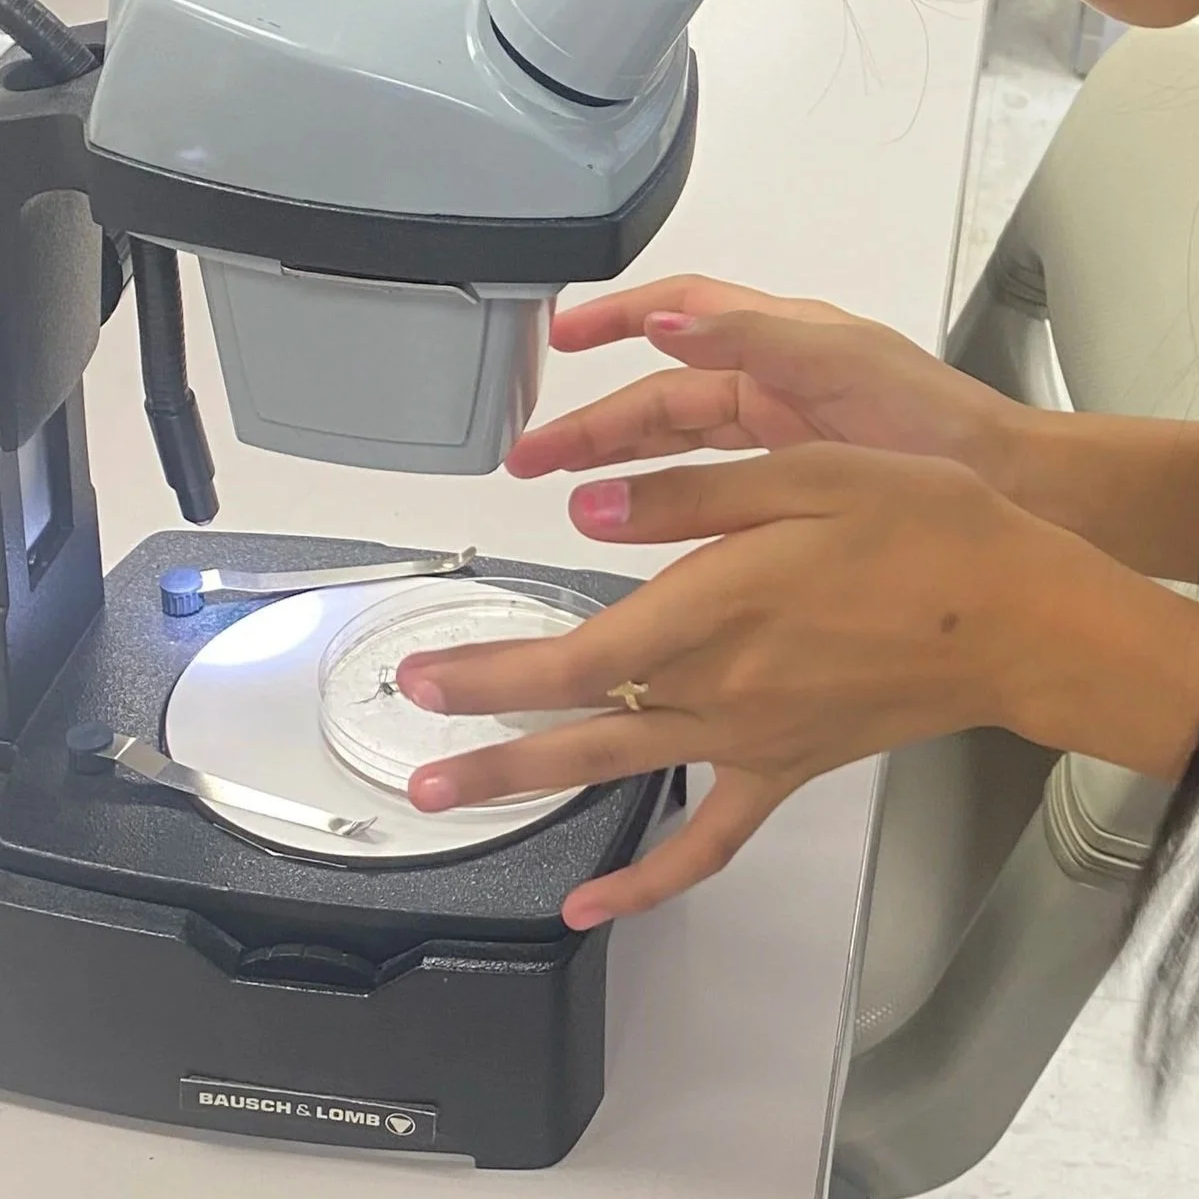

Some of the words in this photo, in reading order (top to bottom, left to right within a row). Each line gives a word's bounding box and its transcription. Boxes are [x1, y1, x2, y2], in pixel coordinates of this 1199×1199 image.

[199, 1092, 291, 1114] BAUSCH
[296, 1103, 312, 1117] &
[316, 1106, 380, 1127] LOMB
